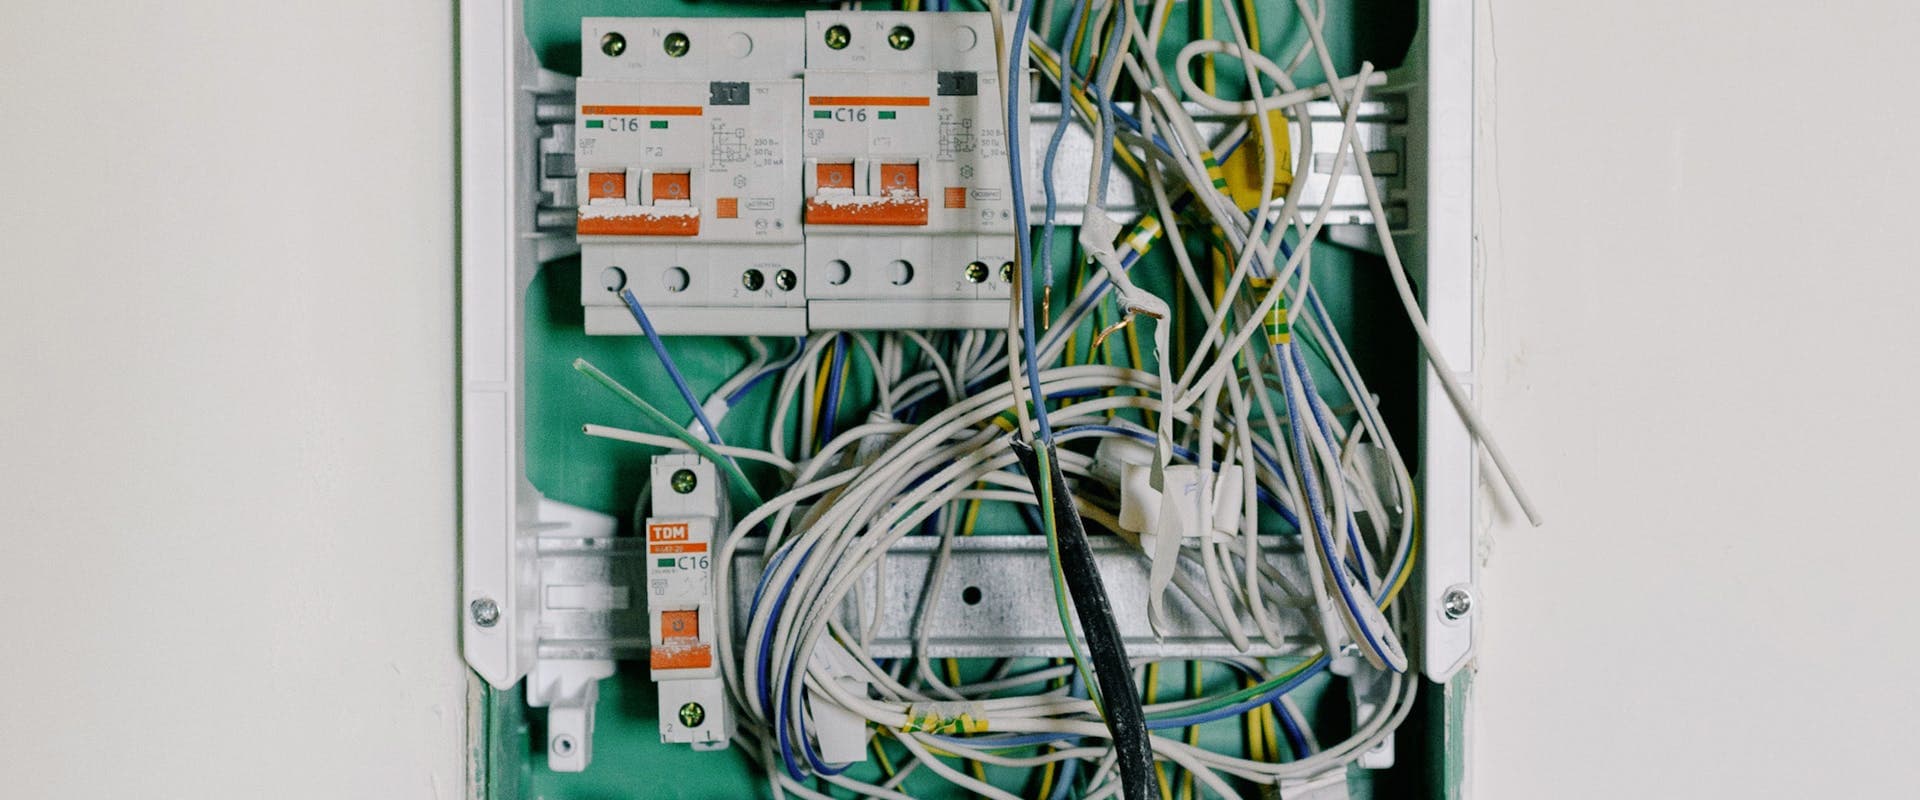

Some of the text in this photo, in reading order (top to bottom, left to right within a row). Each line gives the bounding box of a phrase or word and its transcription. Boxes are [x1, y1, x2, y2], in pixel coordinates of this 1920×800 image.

[834, 107, 867, 122] C16
[607, 117, 639, 132] C16
[653, 526, 686, 540] TDM
[677, 555, 709, 571] C16
